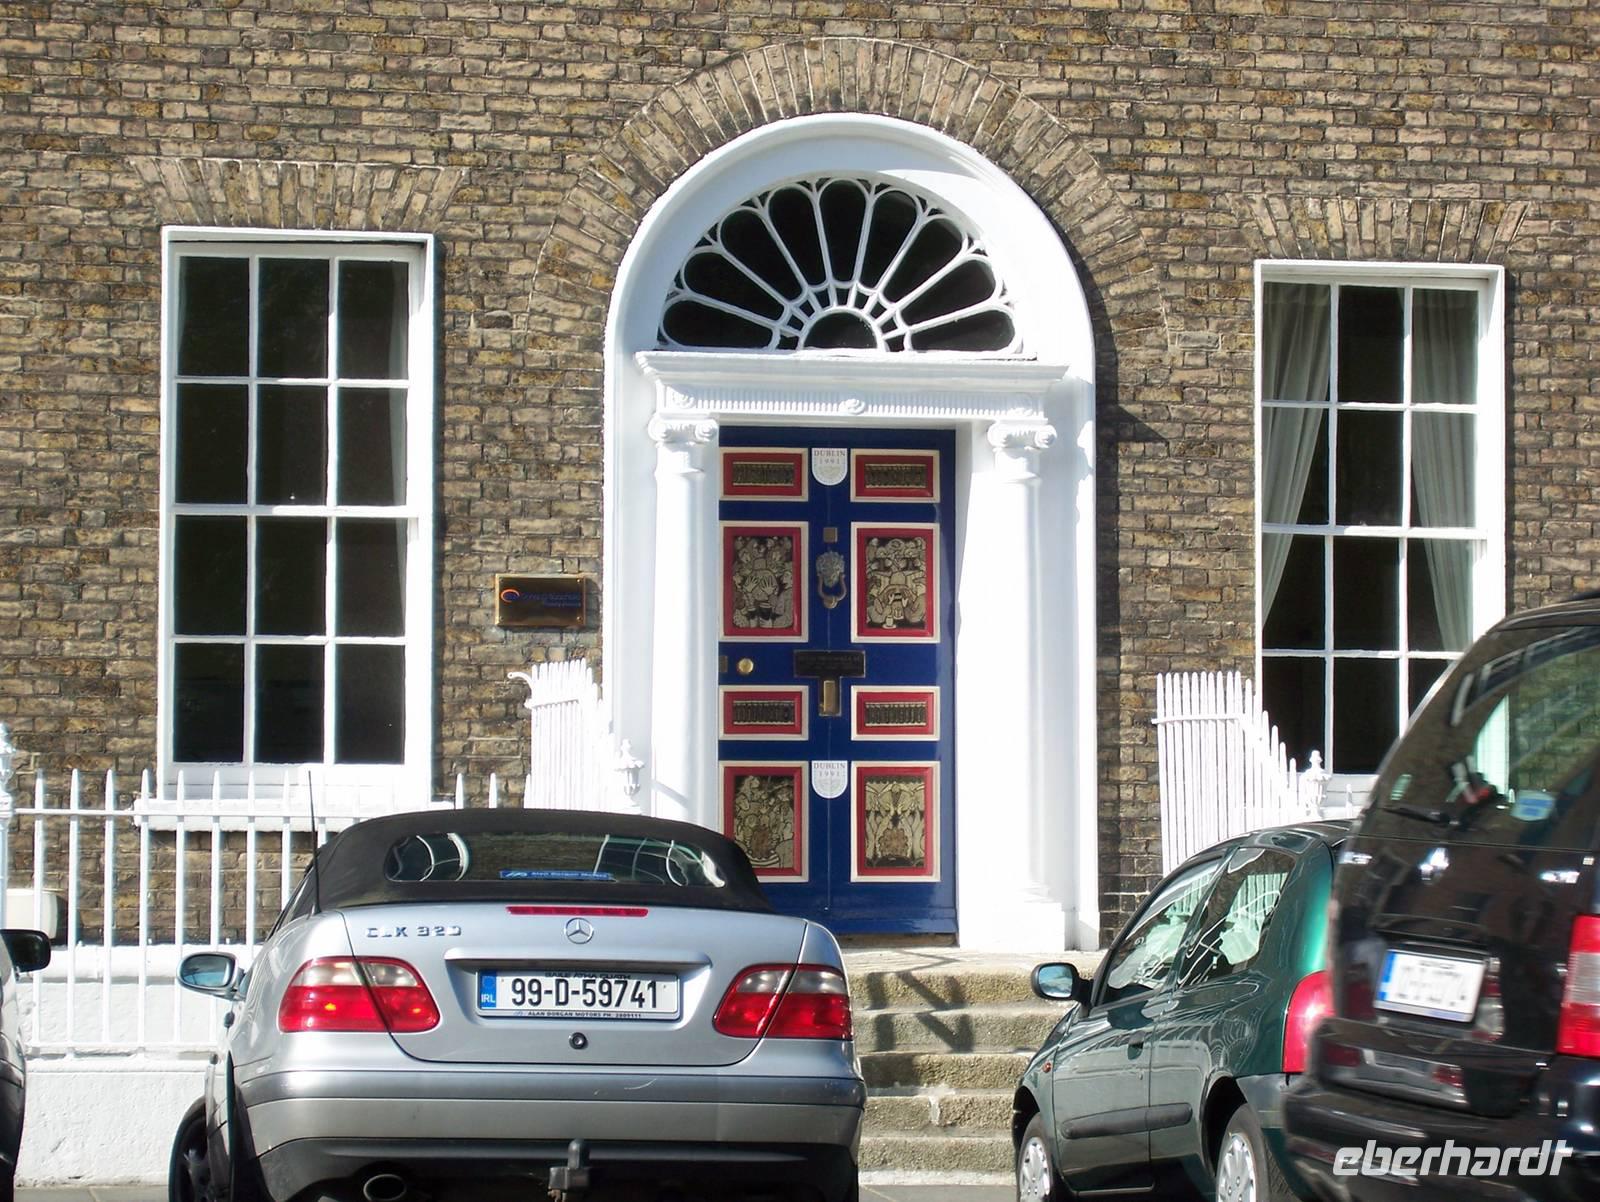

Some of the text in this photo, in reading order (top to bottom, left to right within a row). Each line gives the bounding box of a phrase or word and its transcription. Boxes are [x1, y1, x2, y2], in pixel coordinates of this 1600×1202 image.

[366, 925, 462, 938] CLK 320
[480, 993, 496, 1004] IRL
[511, 977, 657, 1009] 99-D-59741
